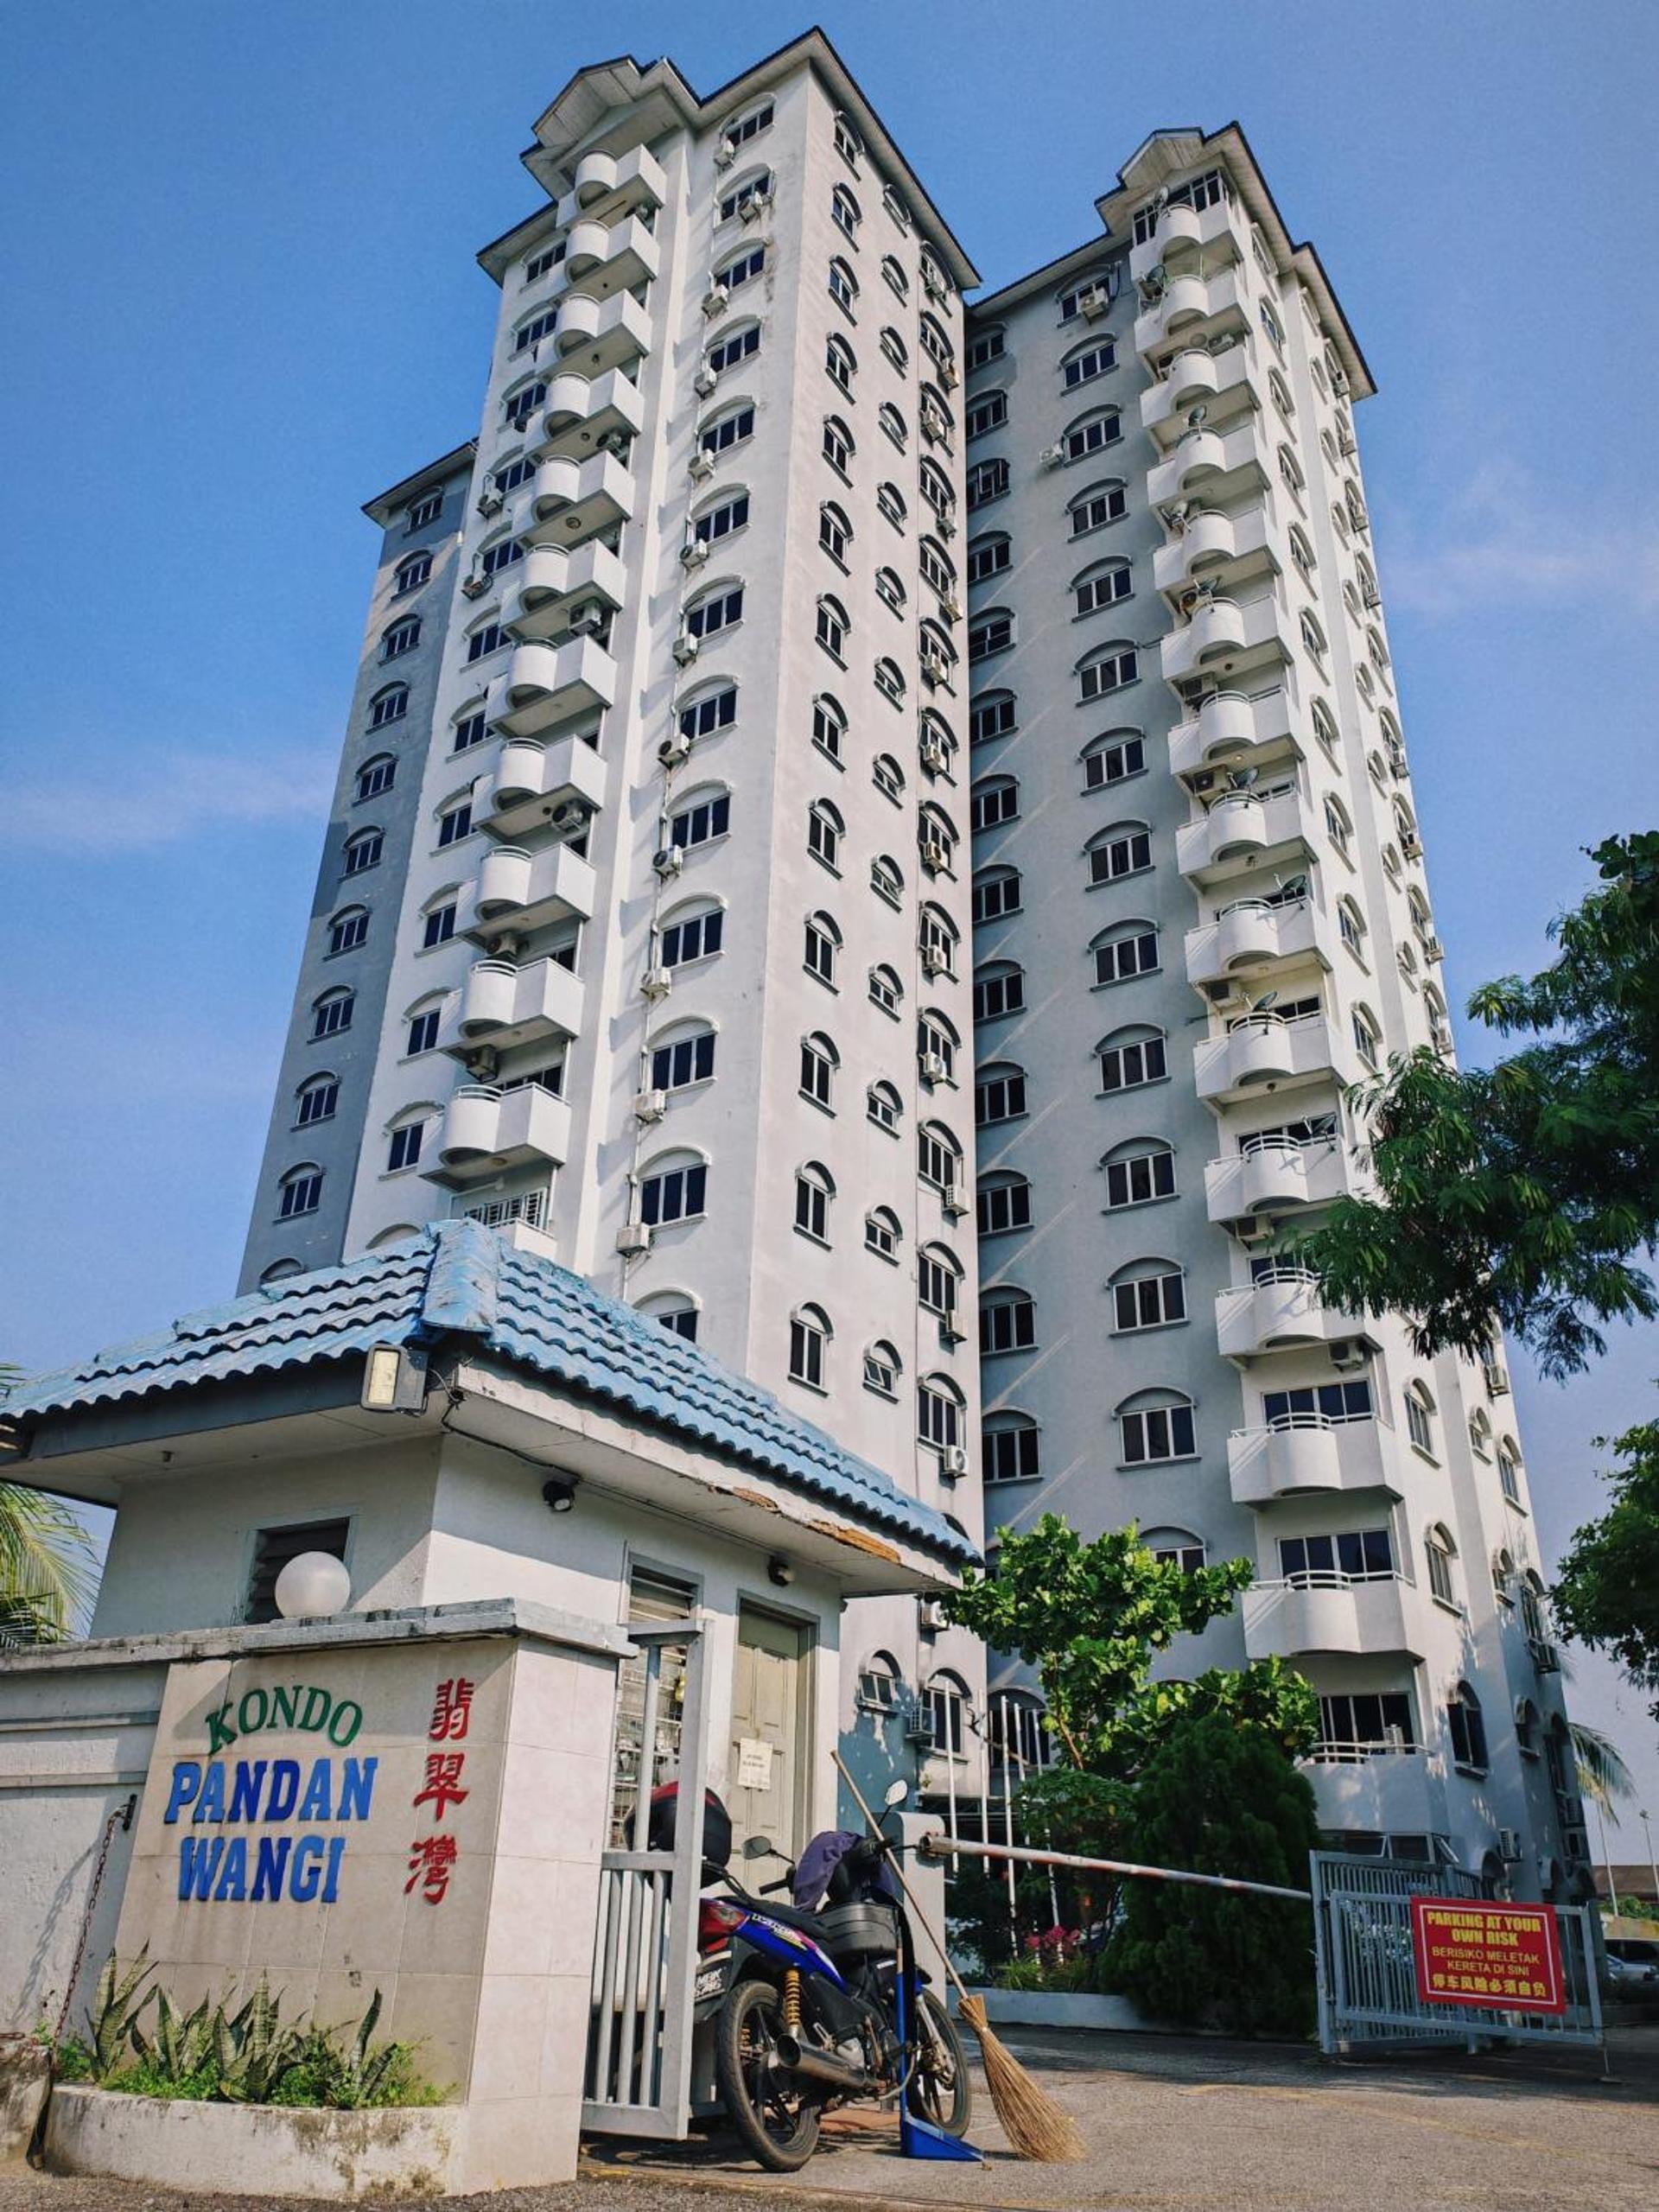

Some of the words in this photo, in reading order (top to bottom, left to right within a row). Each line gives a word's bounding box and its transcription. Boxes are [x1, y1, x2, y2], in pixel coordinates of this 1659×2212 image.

[204, 1685, 363, 1756] KONDO
[163, 1757, 378, 1824] PANDAN
[178, 1834, 346, 1904] WANGI
[1427, 1911, 1484, 1929] PARKING
[1486, 1915, 1502, 1929] AT
[1503, 1916, 1541, 1932] YOUR
[1452, 1929, 1484, 1943] OWN
[1486, 1930, 1519, 1946] RISK
[1432, 1946, 1484, 1961] BERISIKO
[1486, 1950, 1540, 1964] MELETAK
[1447, 1960, 1491, 1974] KERETA
[1493, 1963, 1505, 1974] DI
[1508, 1966, 1529, 1976] SINI
